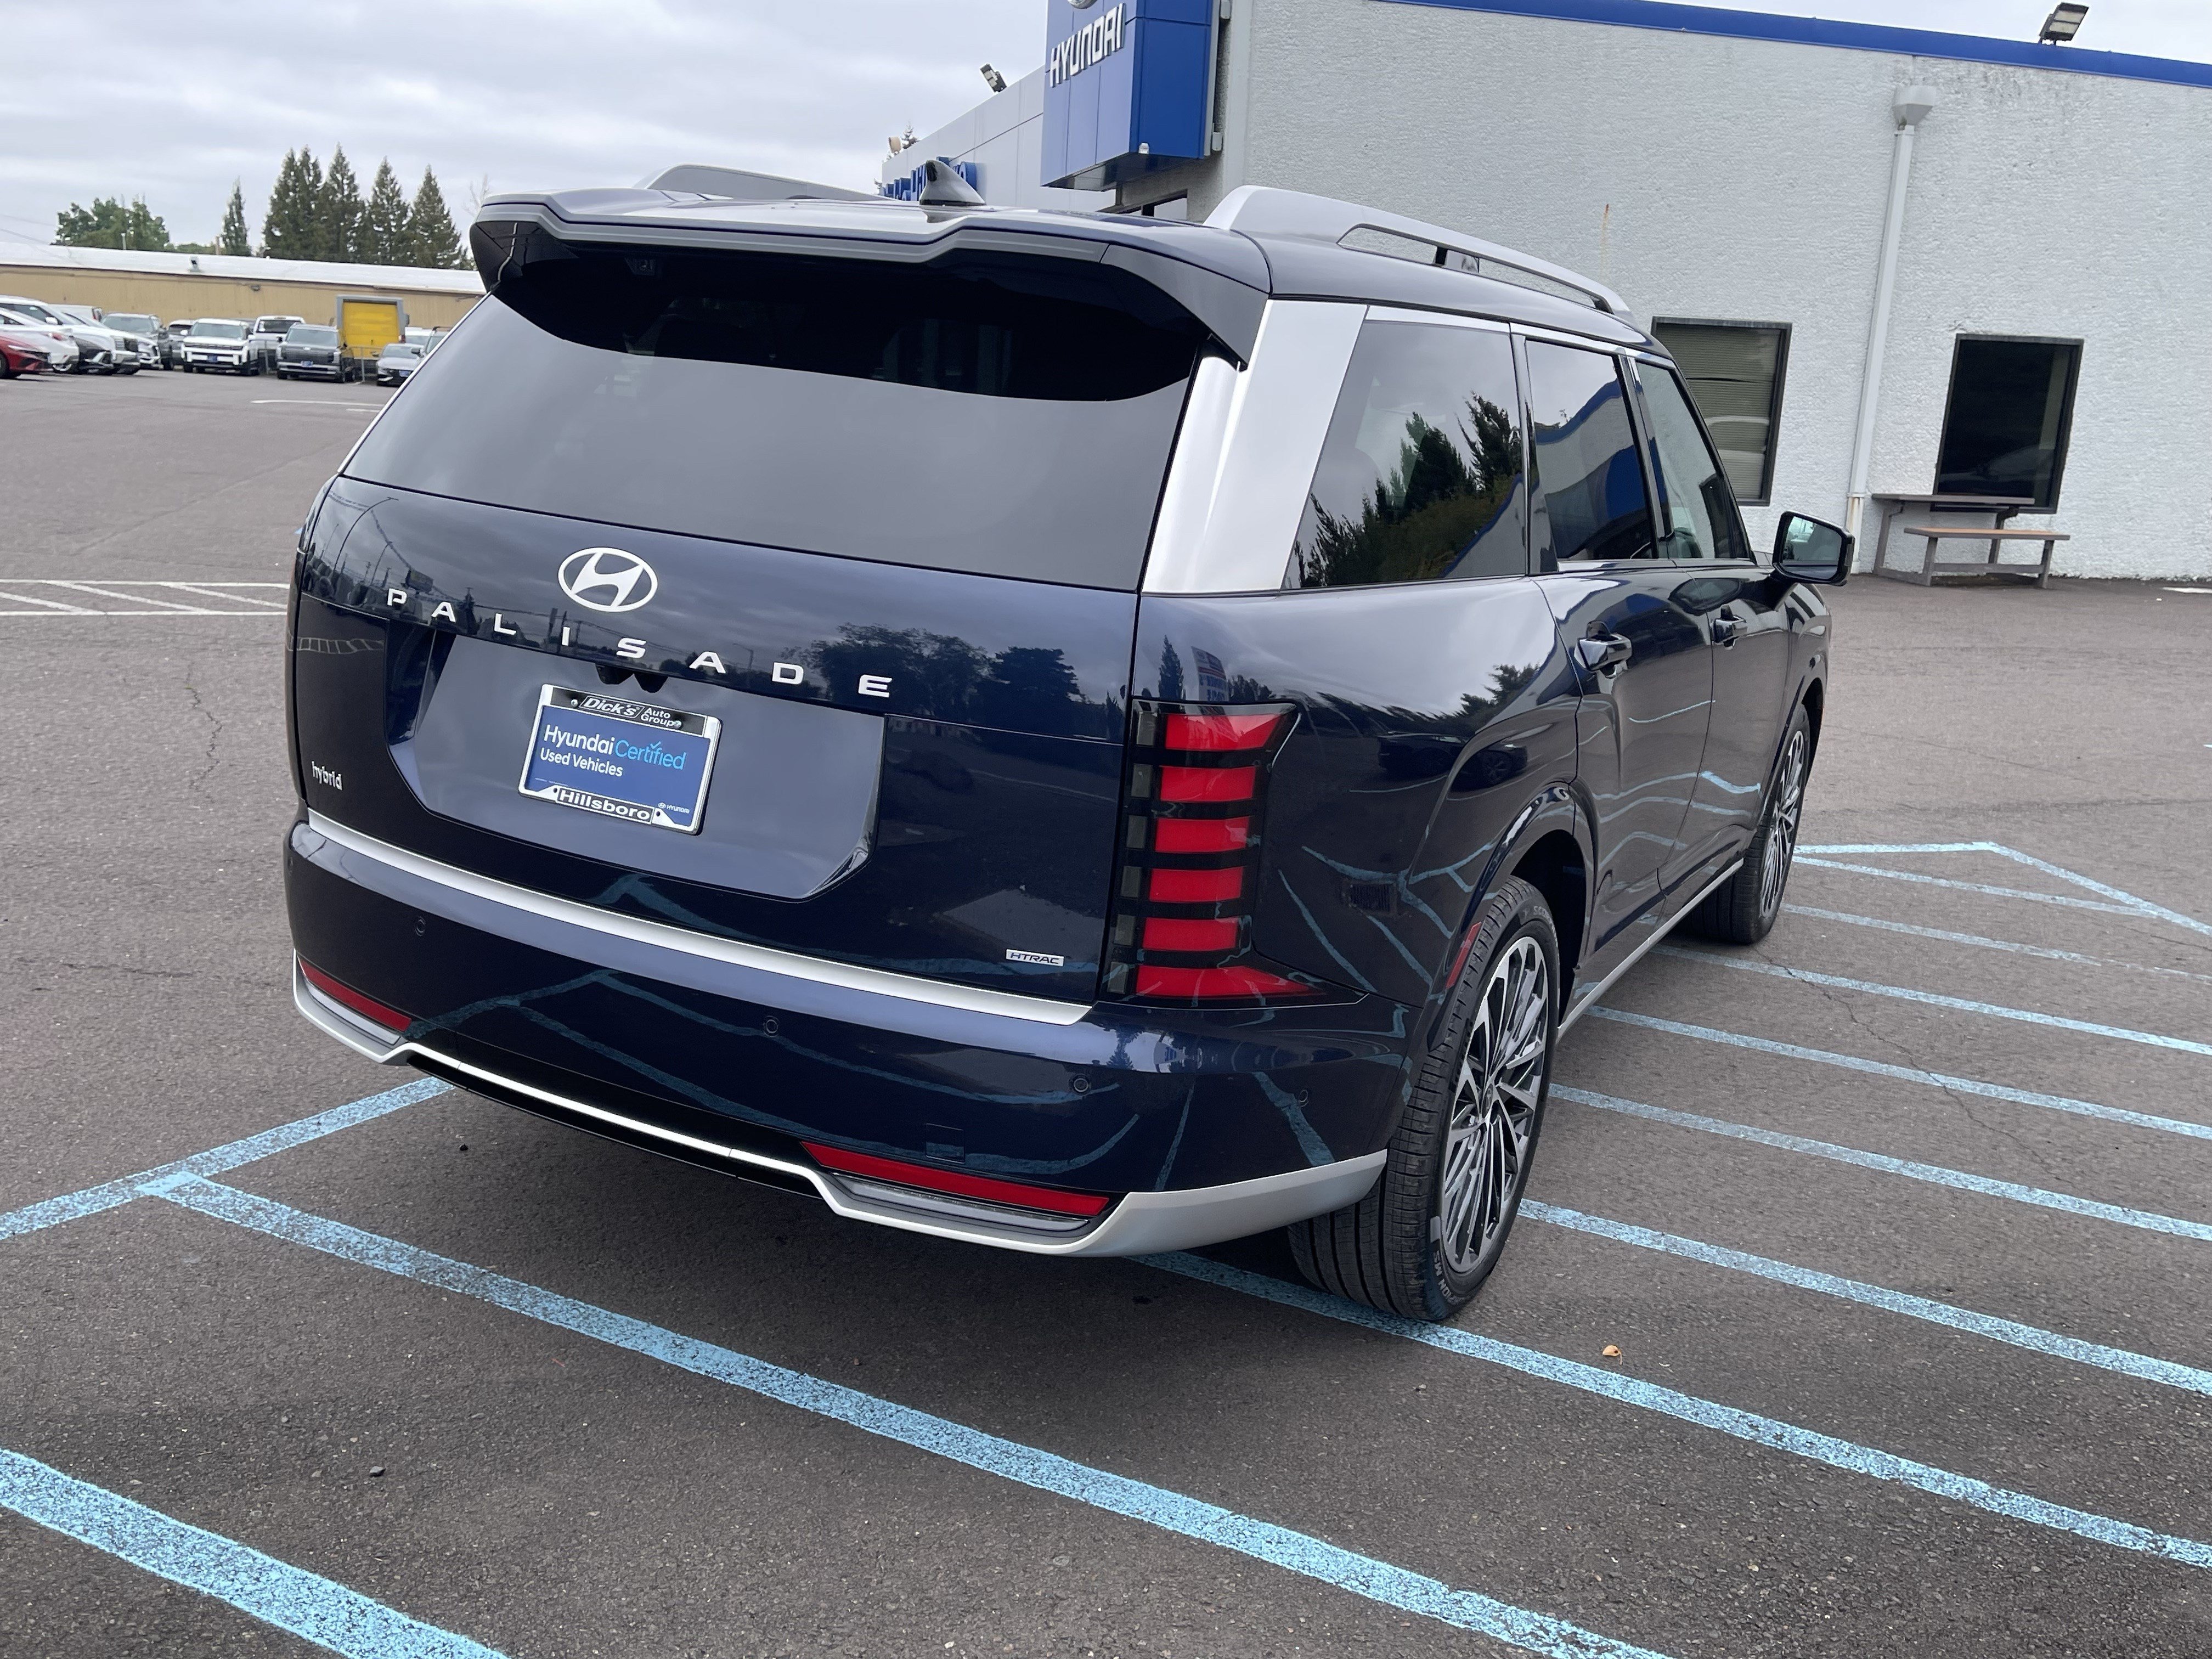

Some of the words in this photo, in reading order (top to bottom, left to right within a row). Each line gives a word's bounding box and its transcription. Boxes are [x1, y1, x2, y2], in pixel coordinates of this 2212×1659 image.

[1050, 3, 1125, 88] HYUNDAI
[387, 588, 893, 697] PALISADE
[583, 697, 637, 716] Dick's
[640, 714, 675, 727] Group
[644, 708, 671, 719] Auto
[540, 747, 571, 765] Used
[573, 754, 624, 777] Vehicles
[544, 724, 616, 755] Hyundai
[614, 740, 686, 770] Certified
[311, 760, 343, 791] hybrid
[559, 789, 650, 820] Hillsboro
[666, 804, 690, 814] HYUNDAI
[1010, 952, 1060, 964] HTRAC
